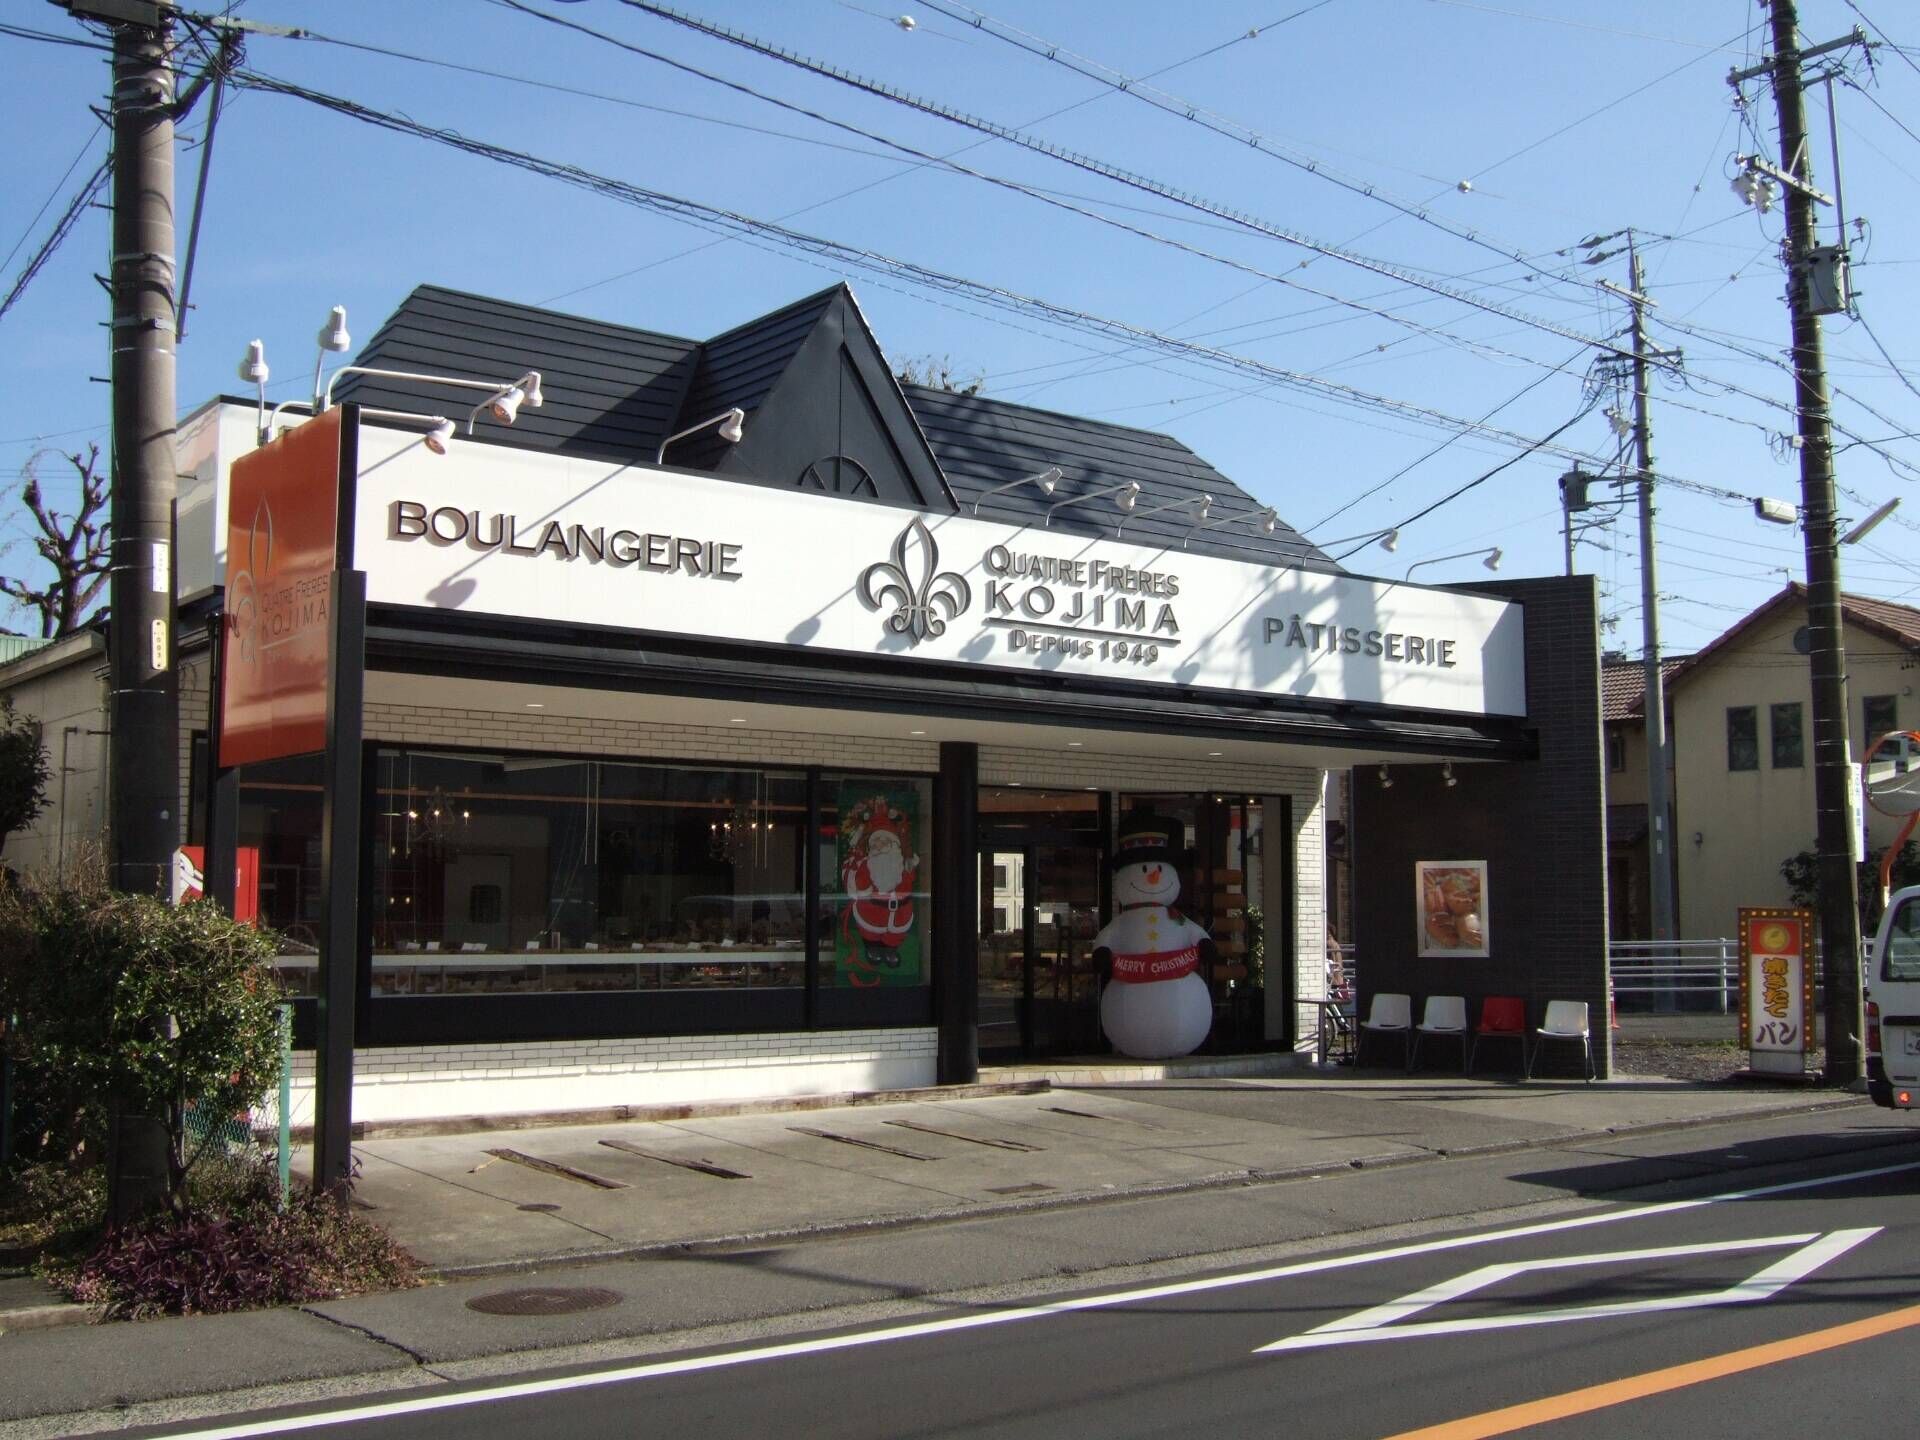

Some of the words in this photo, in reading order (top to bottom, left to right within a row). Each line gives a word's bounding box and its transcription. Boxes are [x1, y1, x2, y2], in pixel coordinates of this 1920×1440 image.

[390, 500, 743, 580] BOULANGERIE
[262, 598, 328, 639] KOJIMA
[988, 580, 1180, 633] KOJIMA
[1100, 640, 1159, 664] 1949
[1263, 614, 1457, 668] PÂTISSERIE
[1115, 957, 1146, 973] MERRY
[1755, 1022, 1797, 1045] パン
